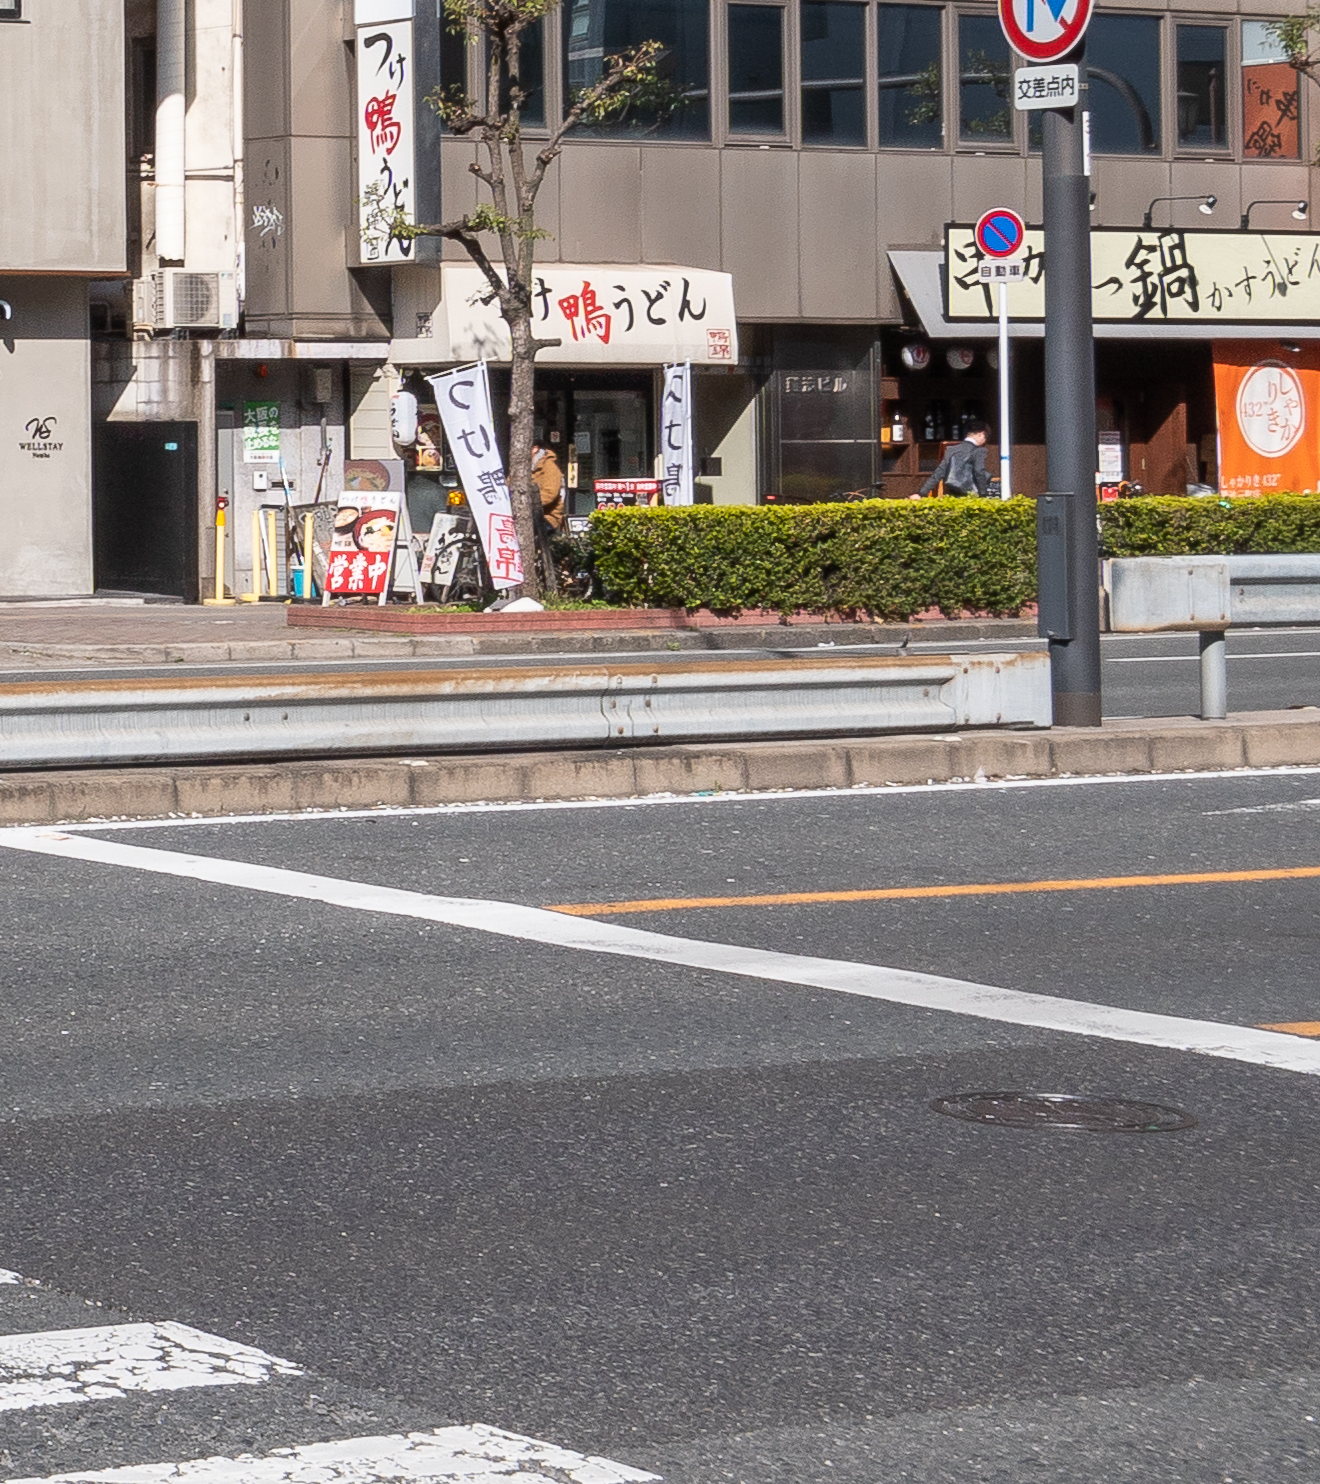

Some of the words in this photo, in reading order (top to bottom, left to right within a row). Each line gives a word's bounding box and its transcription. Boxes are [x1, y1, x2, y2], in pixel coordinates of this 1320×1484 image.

[1017, 74, 1075, 100] 交差点内
[981, 265, 1020, 278] 自動車
[479, 277, 708, 345] け鴨うどん
[18, 442, 64, 451] WELLSTAY
[328, 552, 387, 591] 営業中
